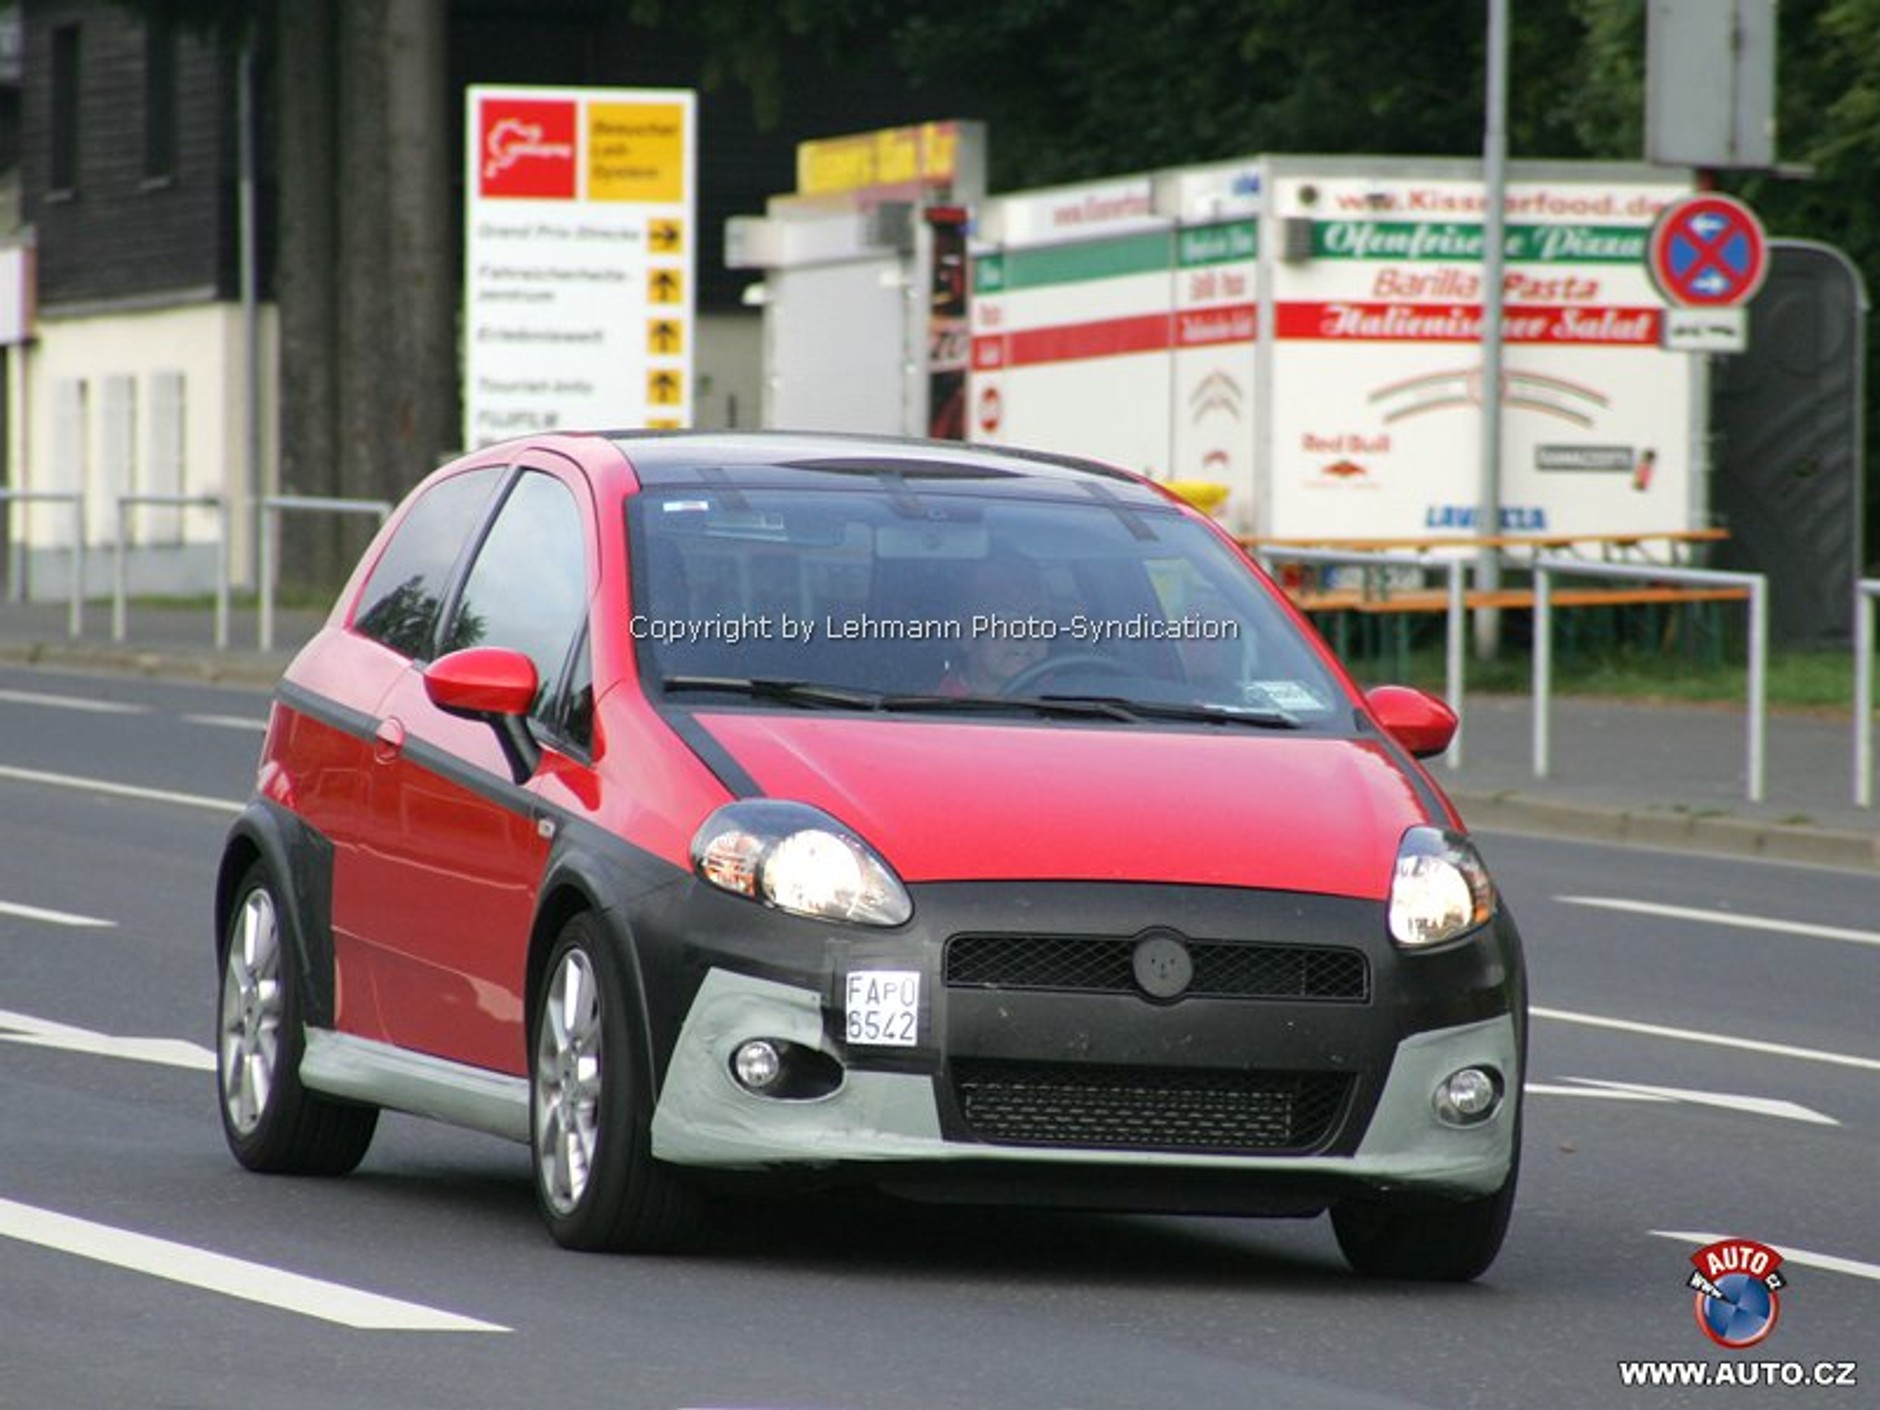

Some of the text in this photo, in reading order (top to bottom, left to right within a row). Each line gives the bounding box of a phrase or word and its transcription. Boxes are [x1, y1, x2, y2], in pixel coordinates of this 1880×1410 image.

[1373, 268, 1598, 299] Barilla Pasta
[1551, 306, 1650, 341] Salat
[1302, 433, 1390, 452] Red Bull
[848, 1010, 915, 1040] 6542
